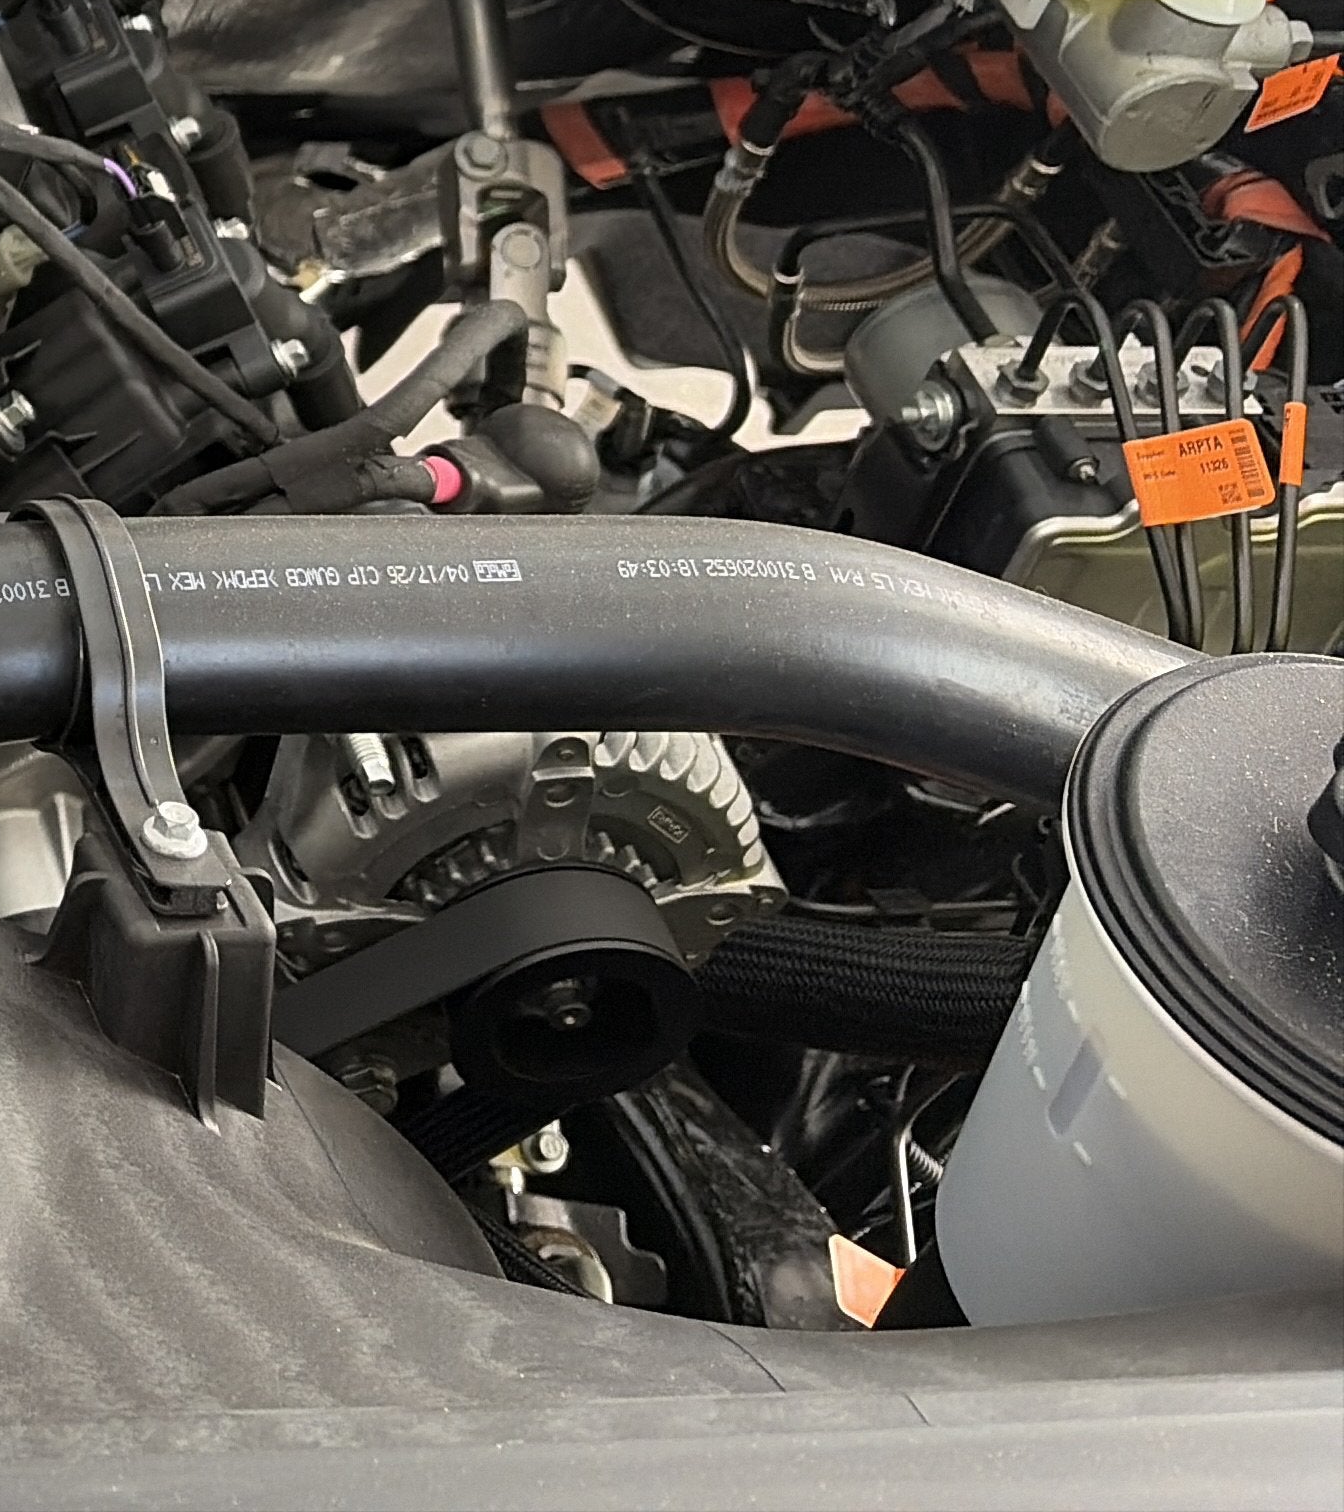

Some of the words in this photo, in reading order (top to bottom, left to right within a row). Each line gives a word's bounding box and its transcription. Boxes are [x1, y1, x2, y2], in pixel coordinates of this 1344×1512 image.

[1178, 435, 1224, 457] ARPTA
[285, 566, 340, 588] GUWCB
[346, 565, 380, 585] CIP
[385, 564, 470, 584] 04/17/26
[475, 561, 518, 579] FoMoCo
[616, 558, 700, 578] 18:03:49
[702, 558, 797, 580] 310020652
[801, 563, 815, 580] B
[54, 578, 70, 597] B
[169, 571, 206, 592] MEX
